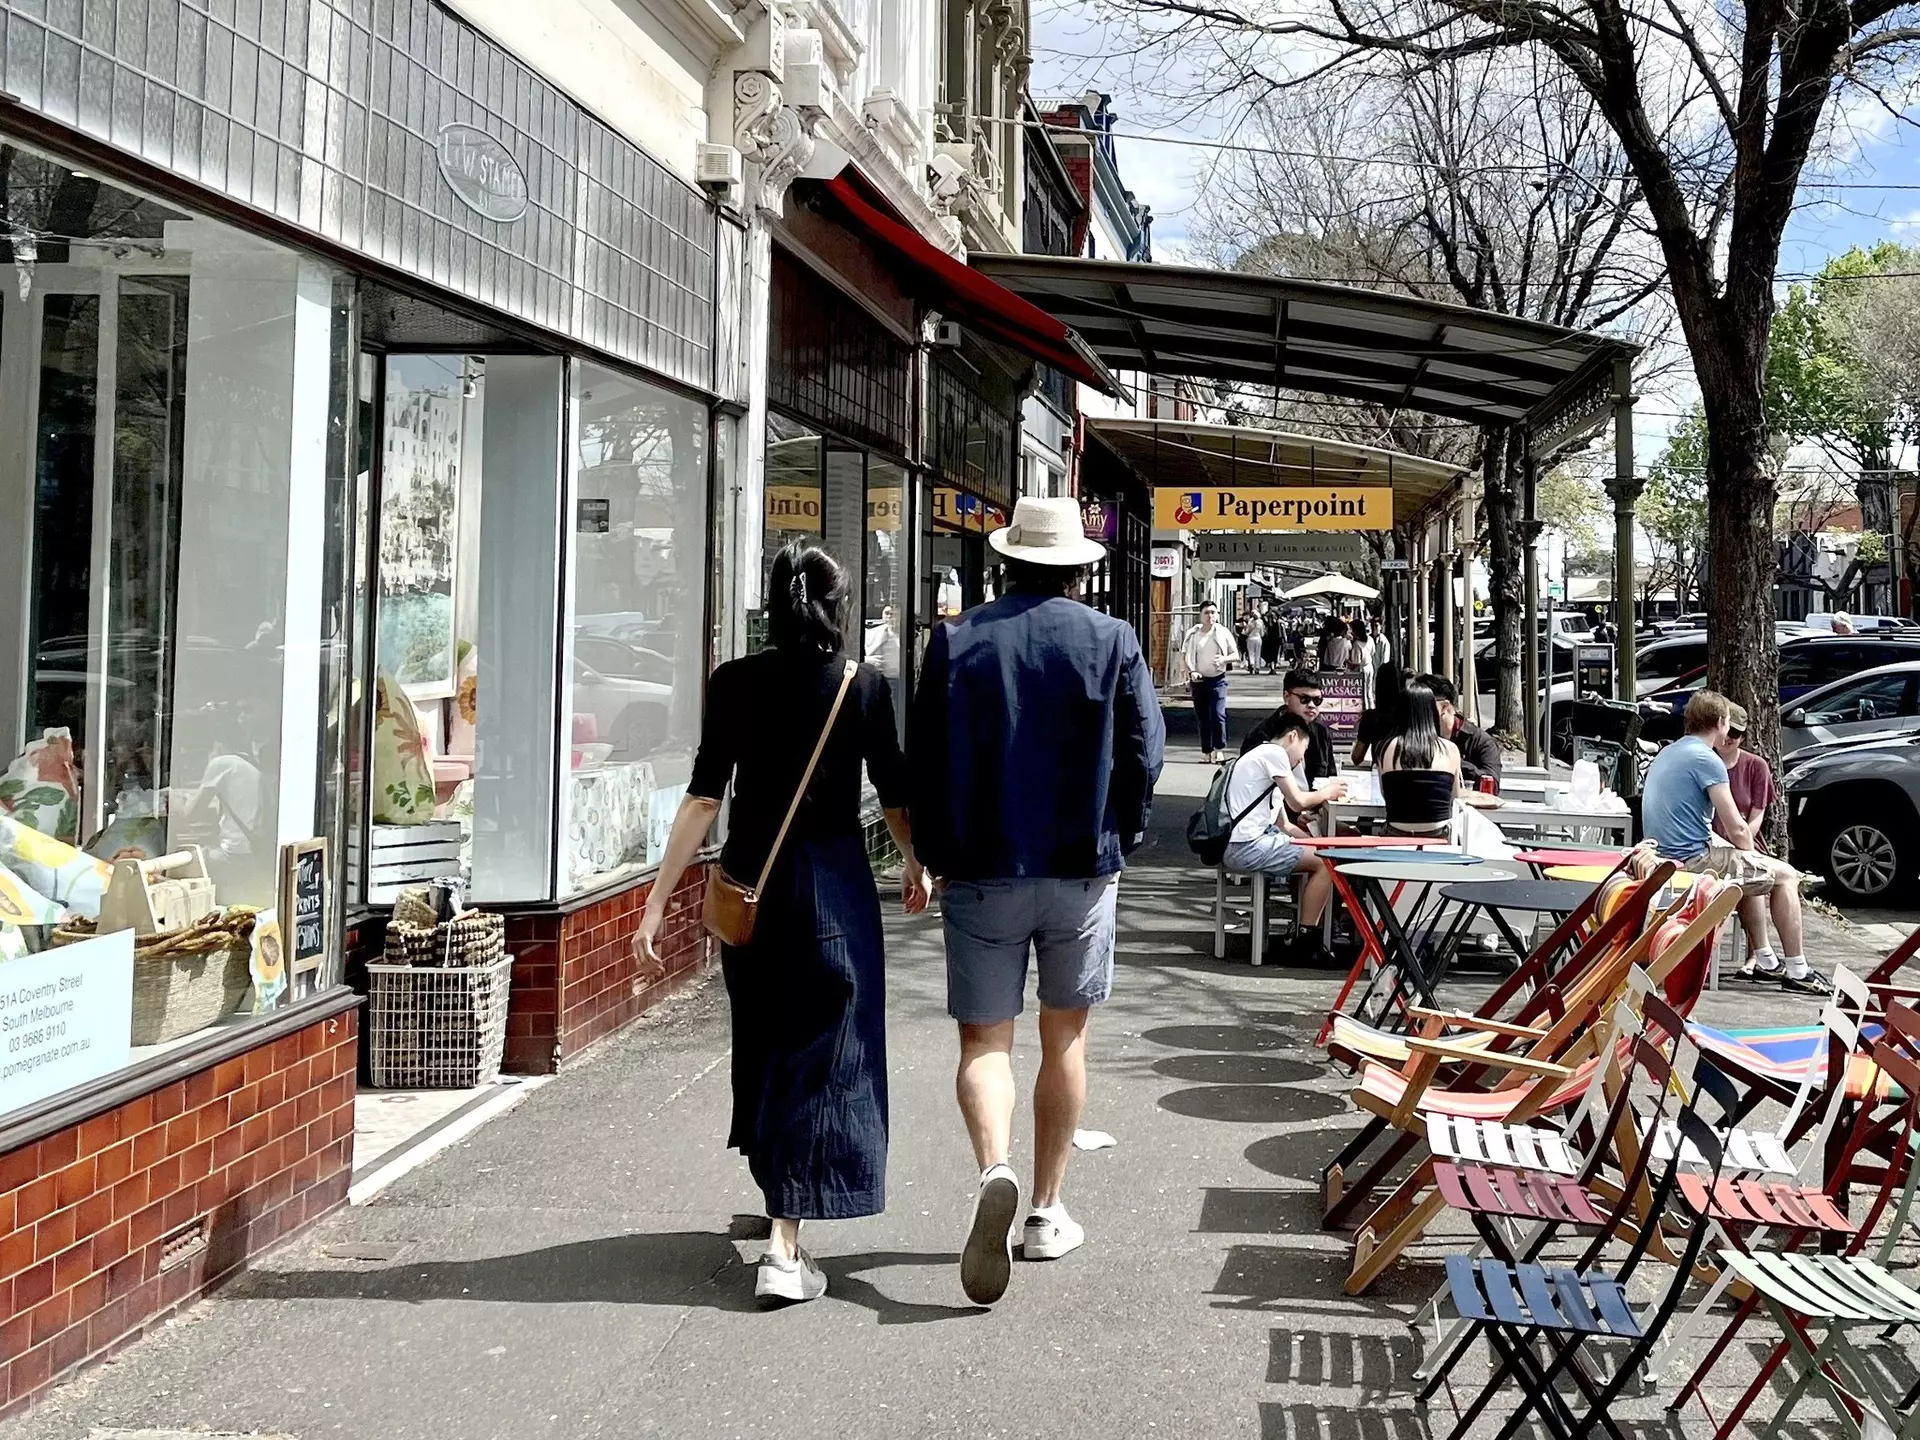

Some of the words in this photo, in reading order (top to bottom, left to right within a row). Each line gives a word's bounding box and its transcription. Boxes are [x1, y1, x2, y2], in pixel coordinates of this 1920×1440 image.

[1081, 508, 1108, 533] Amy
[1216, 492, 1367, 525] Paperpoint
[1274, 545, 1298, 553] HAIR
[1303, 545, 1355, 553] ORGANICS
[1321, 686, 1363, 696] MASSAGE
[1341, 678, 1363, 686] THAI
[1320, 713, 1340, 721] NOW
[1341, 713, 1359, 722] OPE
[19, 983, 57, 1004] Coventry
[59, 973, 83, 992] Street
[2, 1012, 28, 1032] South
[30, 1000, 74, 1024] Melbourne
[9, 1036, 20, 1053] 03
[46, 1021, 66, 1040] 9110
[0, 1037, 91, 1081] .pomegranate.com.au
